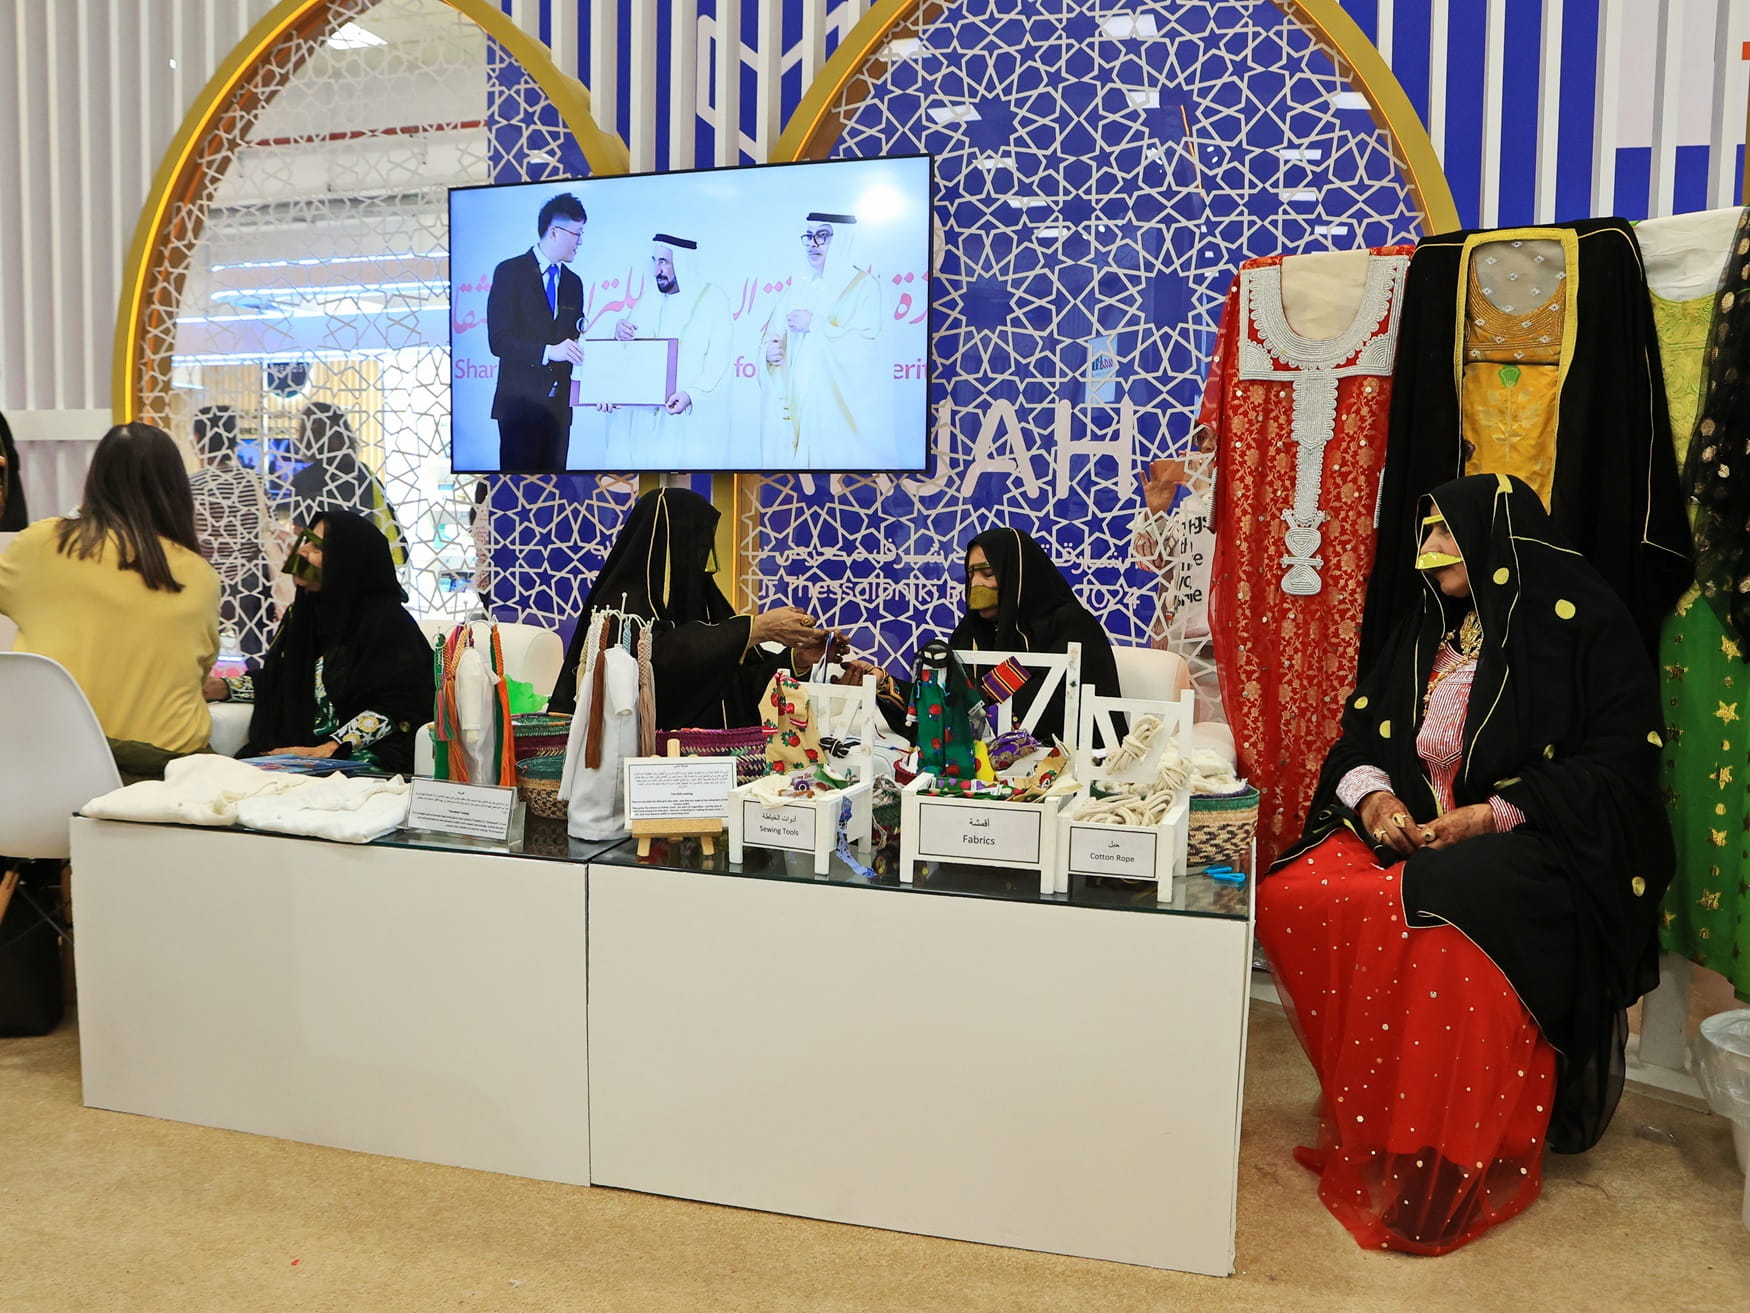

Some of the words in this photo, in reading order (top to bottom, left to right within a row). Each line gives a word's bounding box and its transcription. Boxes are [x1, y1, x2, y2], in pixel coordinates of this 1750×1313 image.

[759, 825, 781, 835] Sewing
[782, 827, 799, 836] Tools
[962, 834, 995, 845] Fabrics
[1090, 852, 1115, 861] Cotton
[1116, 855, 1135, 863] Rope
